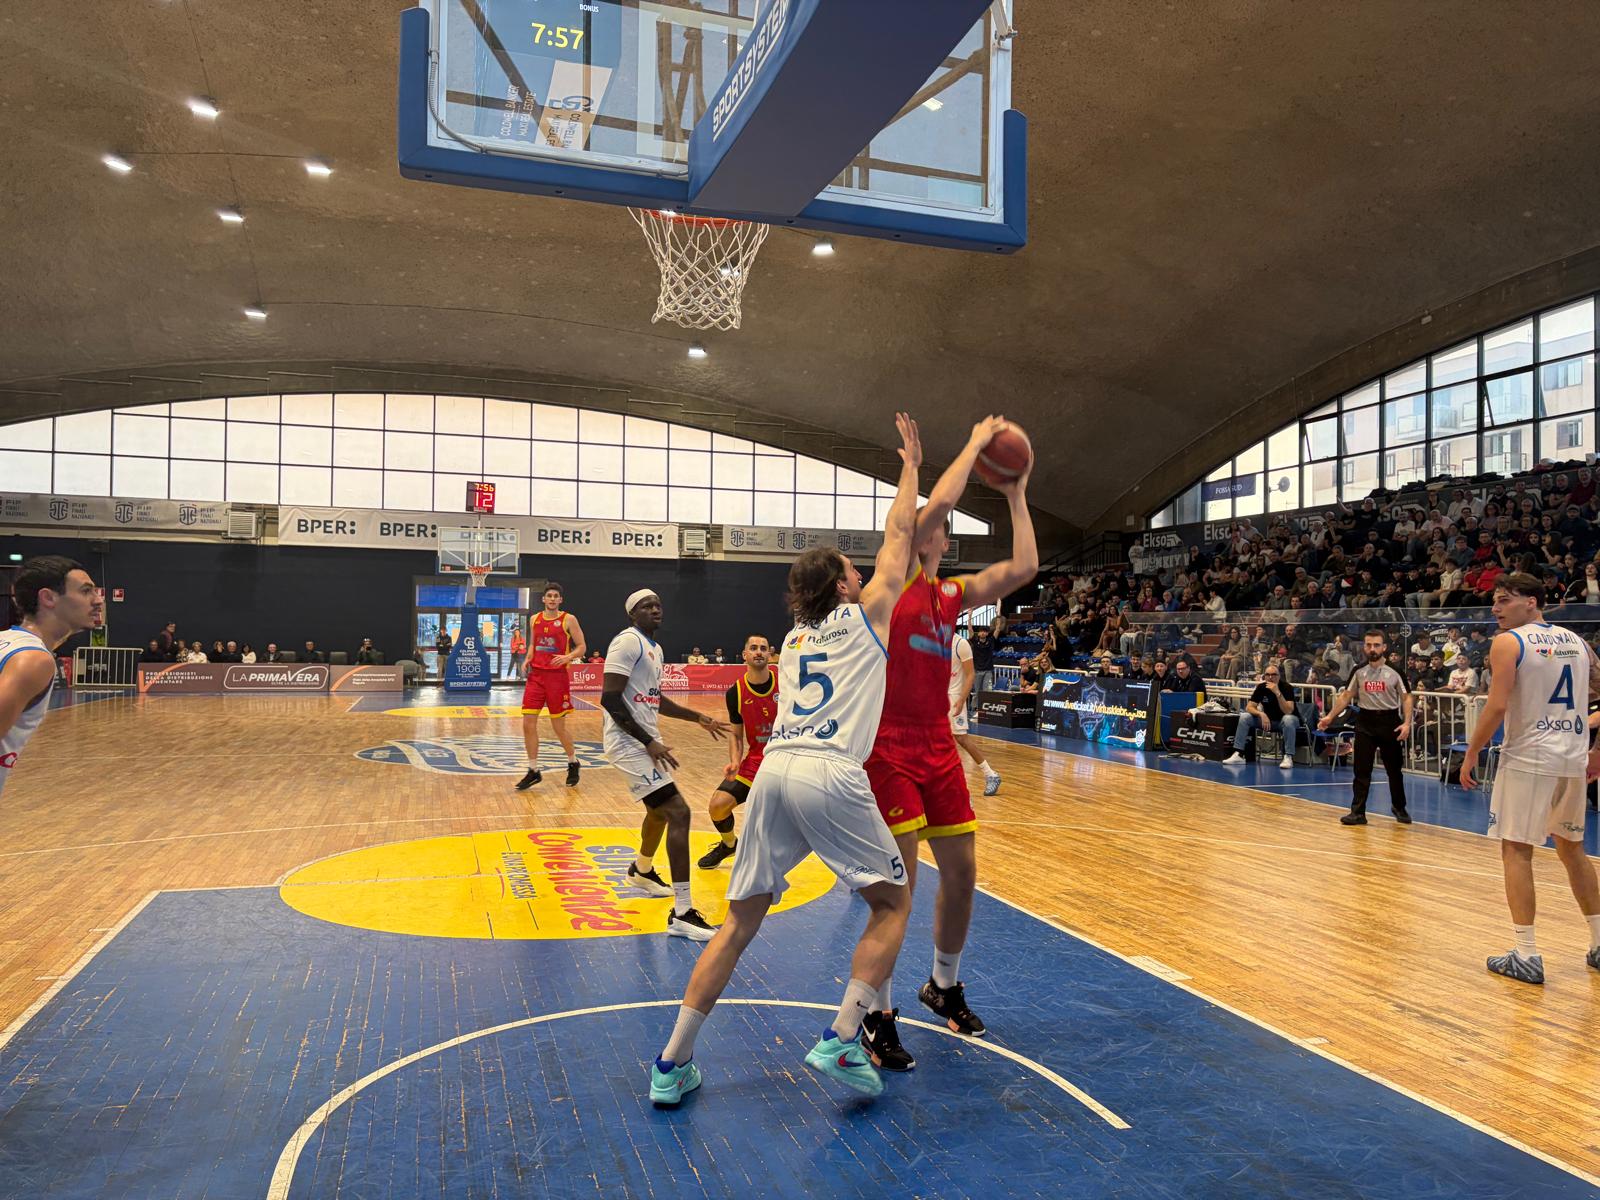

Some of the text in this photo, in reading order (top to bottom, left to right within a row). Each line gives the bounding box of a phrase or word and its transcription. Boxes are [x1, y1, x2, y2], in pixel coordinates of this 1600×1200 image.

[579, 4, 599, 12] BONUS
[531, 22, 584, 50] 7:57
[476, 492, 492, 507] 12
[1143, 532, 1167, 548] Ekso
[573, 672, 596, 681] Eligo
[792, 652, 834, 716] 5
[1548, 664, 1575, 710] 4
[762, 707, 769, 716] 5
[982, 703, 1008, 712] C-HR
[1536, 716, 1572, 731] ekso
[1176, 727, 1216, 742] C-HR
[642, 768, 662, 785] 14
[890, 856, 904, 879] 5
